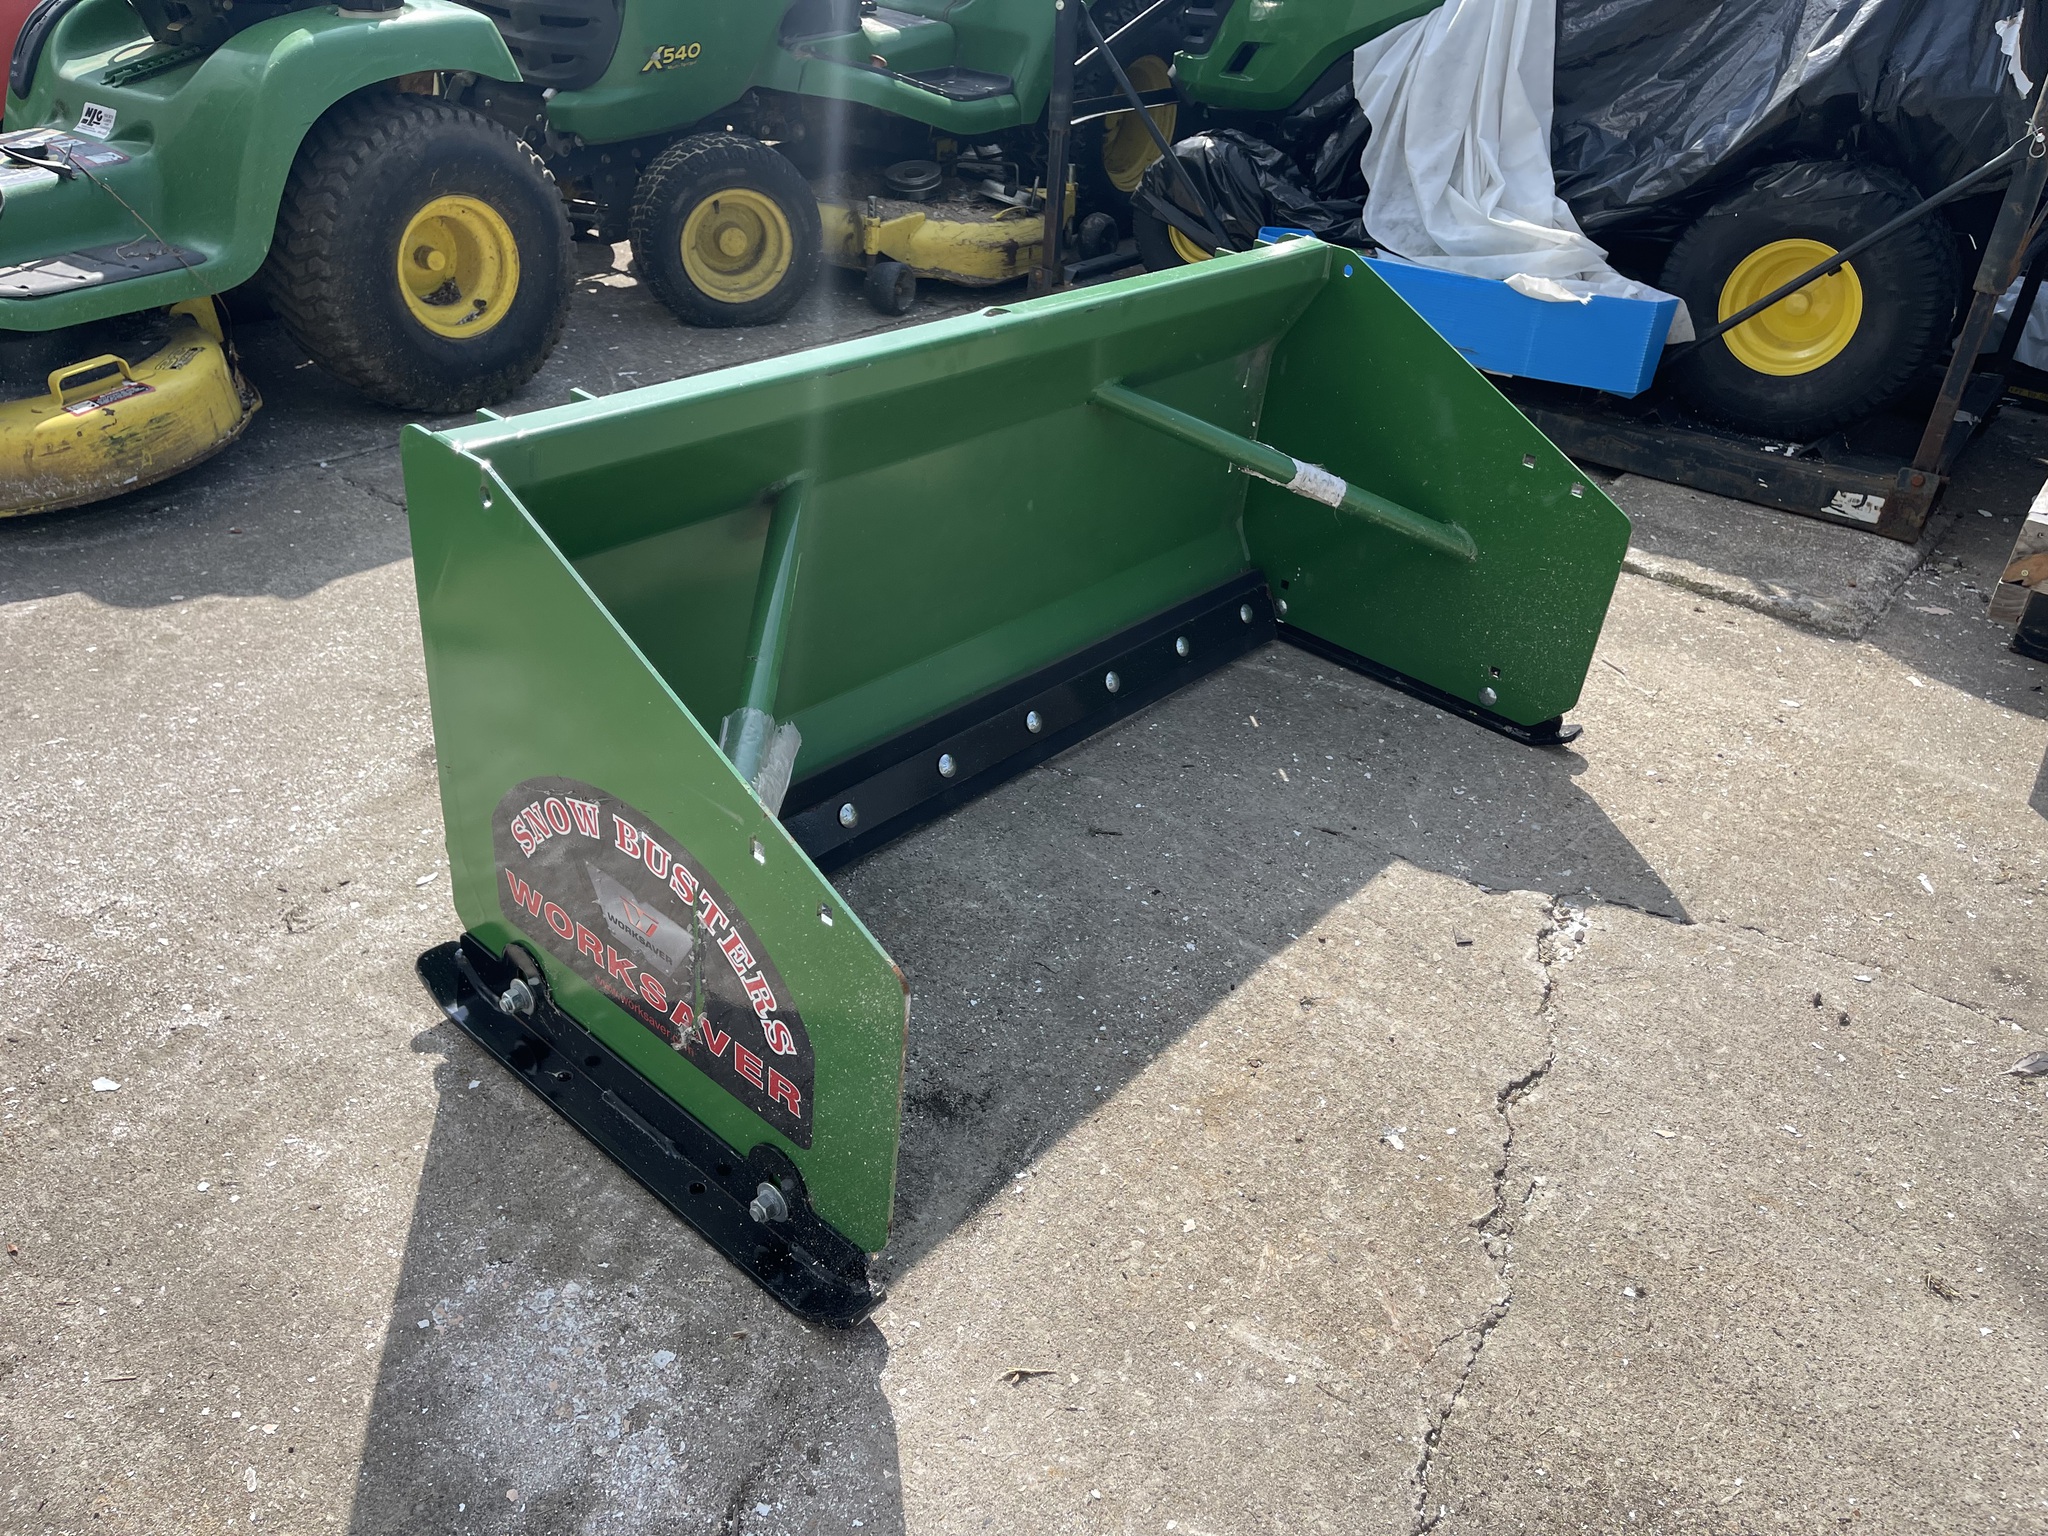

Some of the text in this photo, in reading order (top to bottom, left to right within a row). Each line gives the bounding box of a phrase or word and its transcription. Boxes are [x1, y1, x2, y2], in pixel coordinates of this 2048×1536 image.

[642, 42, 701, 72] X540
[511, 797, 797, 1056] SNOW BUSTERS
[607, 911, 673, 966] WORKSAVER
[505, 868, 801, 1118] WORKSAVER
[594, 974, 695, 1057] www.worksavercm
